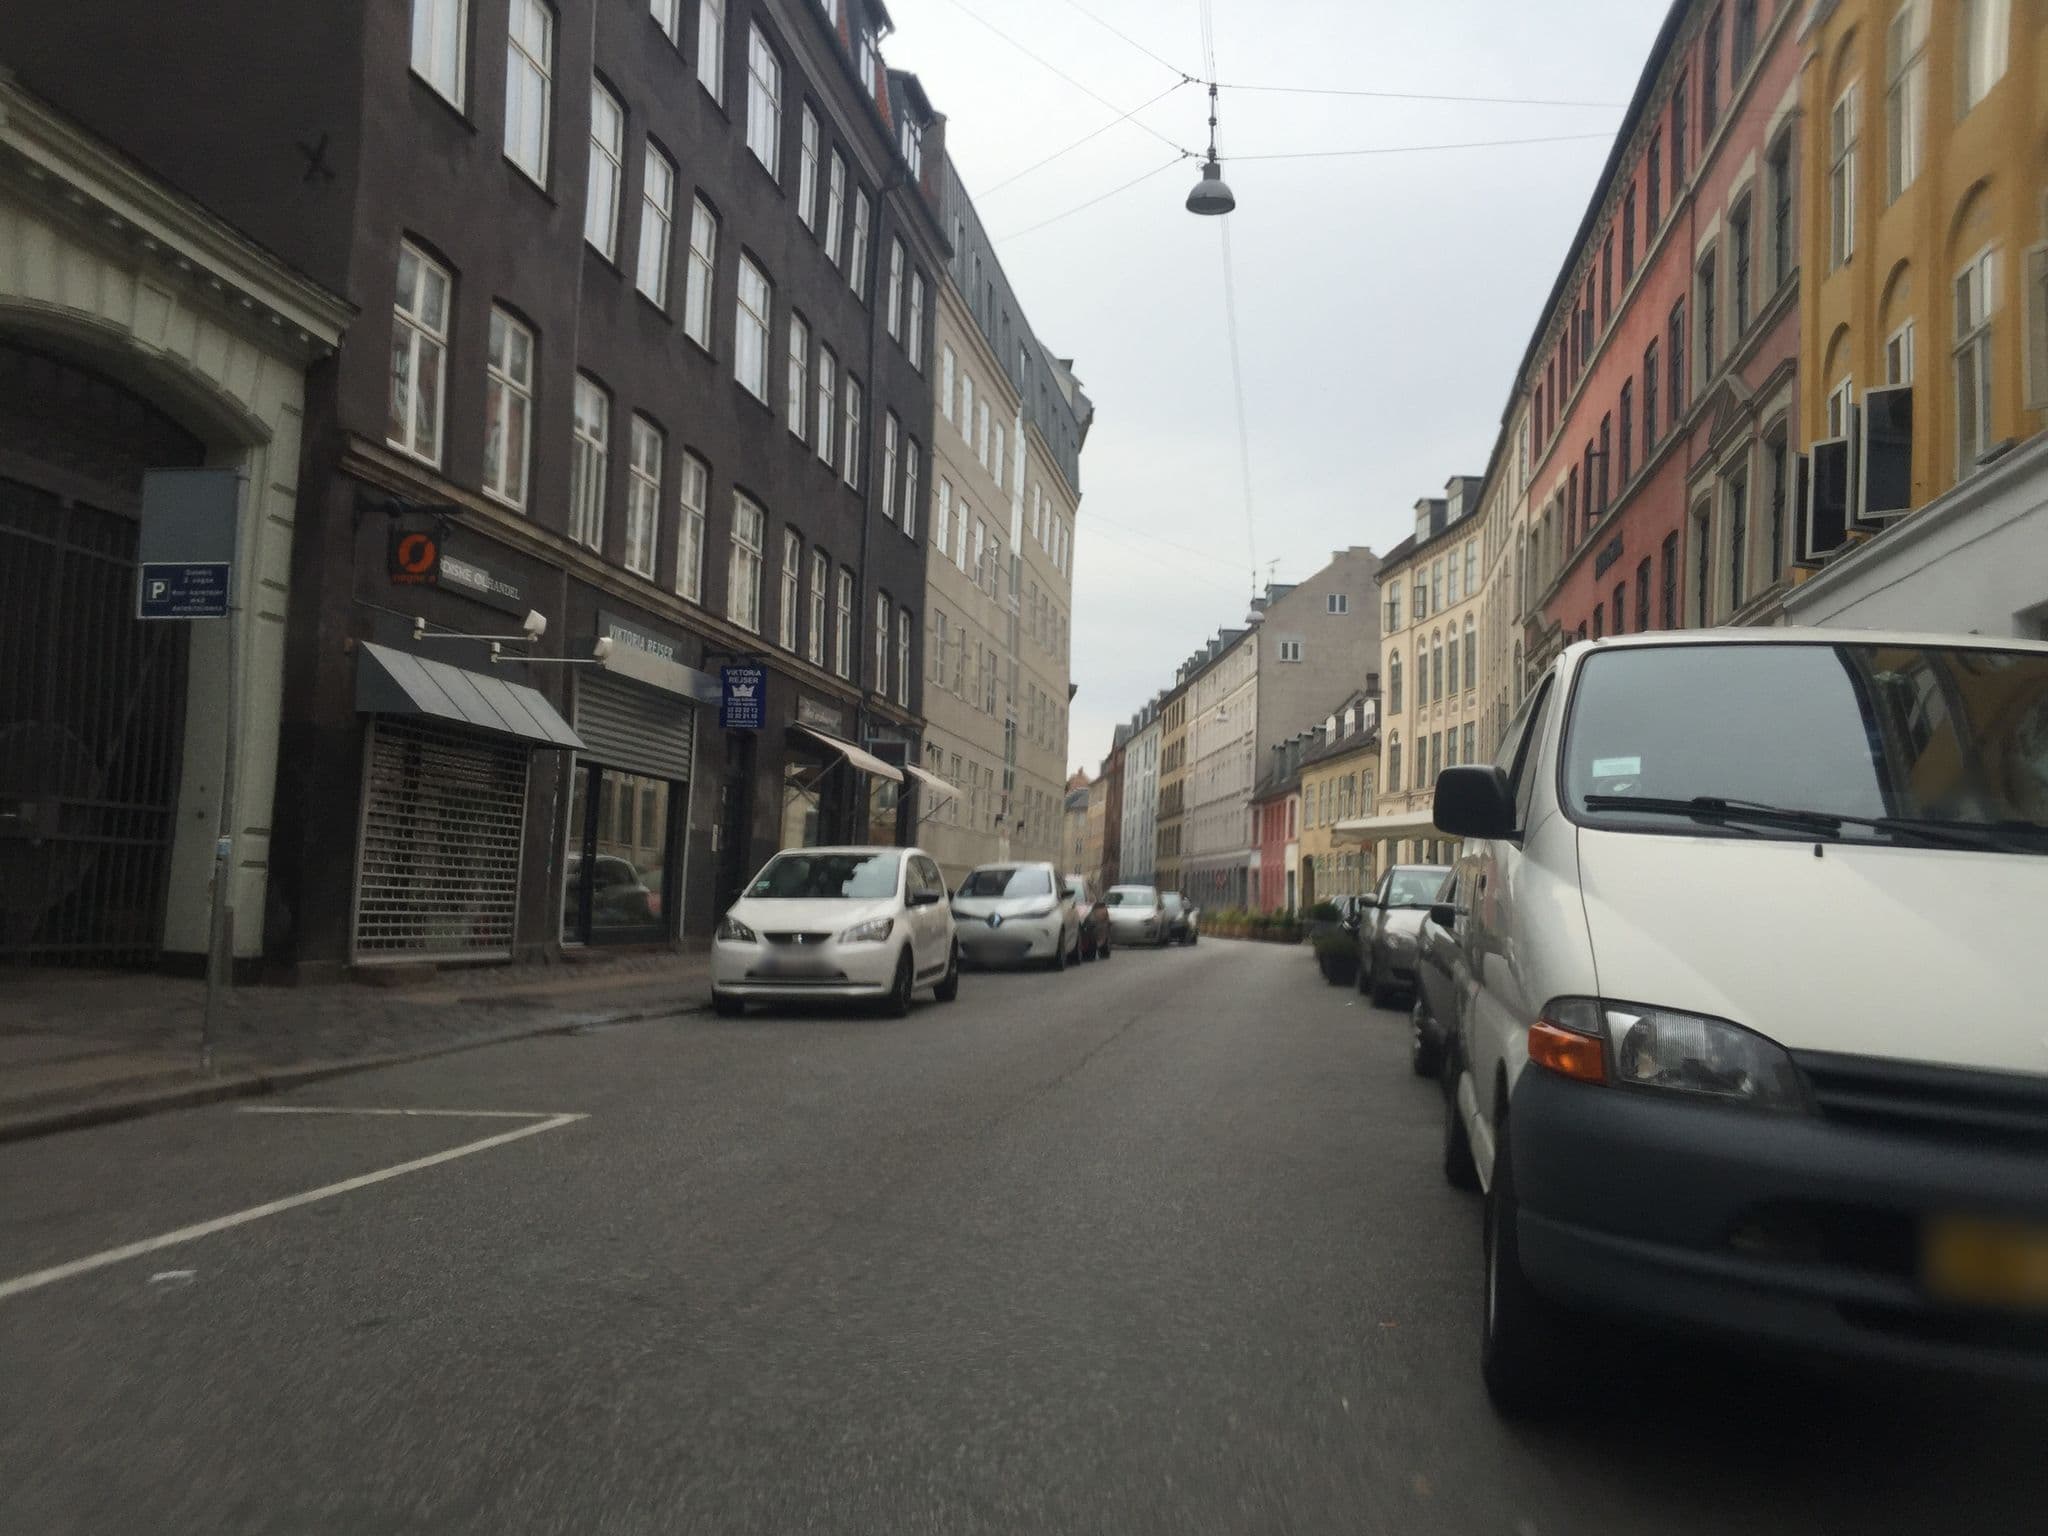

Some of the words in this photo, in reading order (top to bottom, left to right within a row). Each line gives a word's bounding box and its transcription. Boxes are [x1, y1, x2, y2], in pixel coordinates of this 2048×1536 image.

[152, 581, 165, 599] P
[726, 669, 762, 677] VIKTORIA
[728, 676, 759, 684] REJSER
